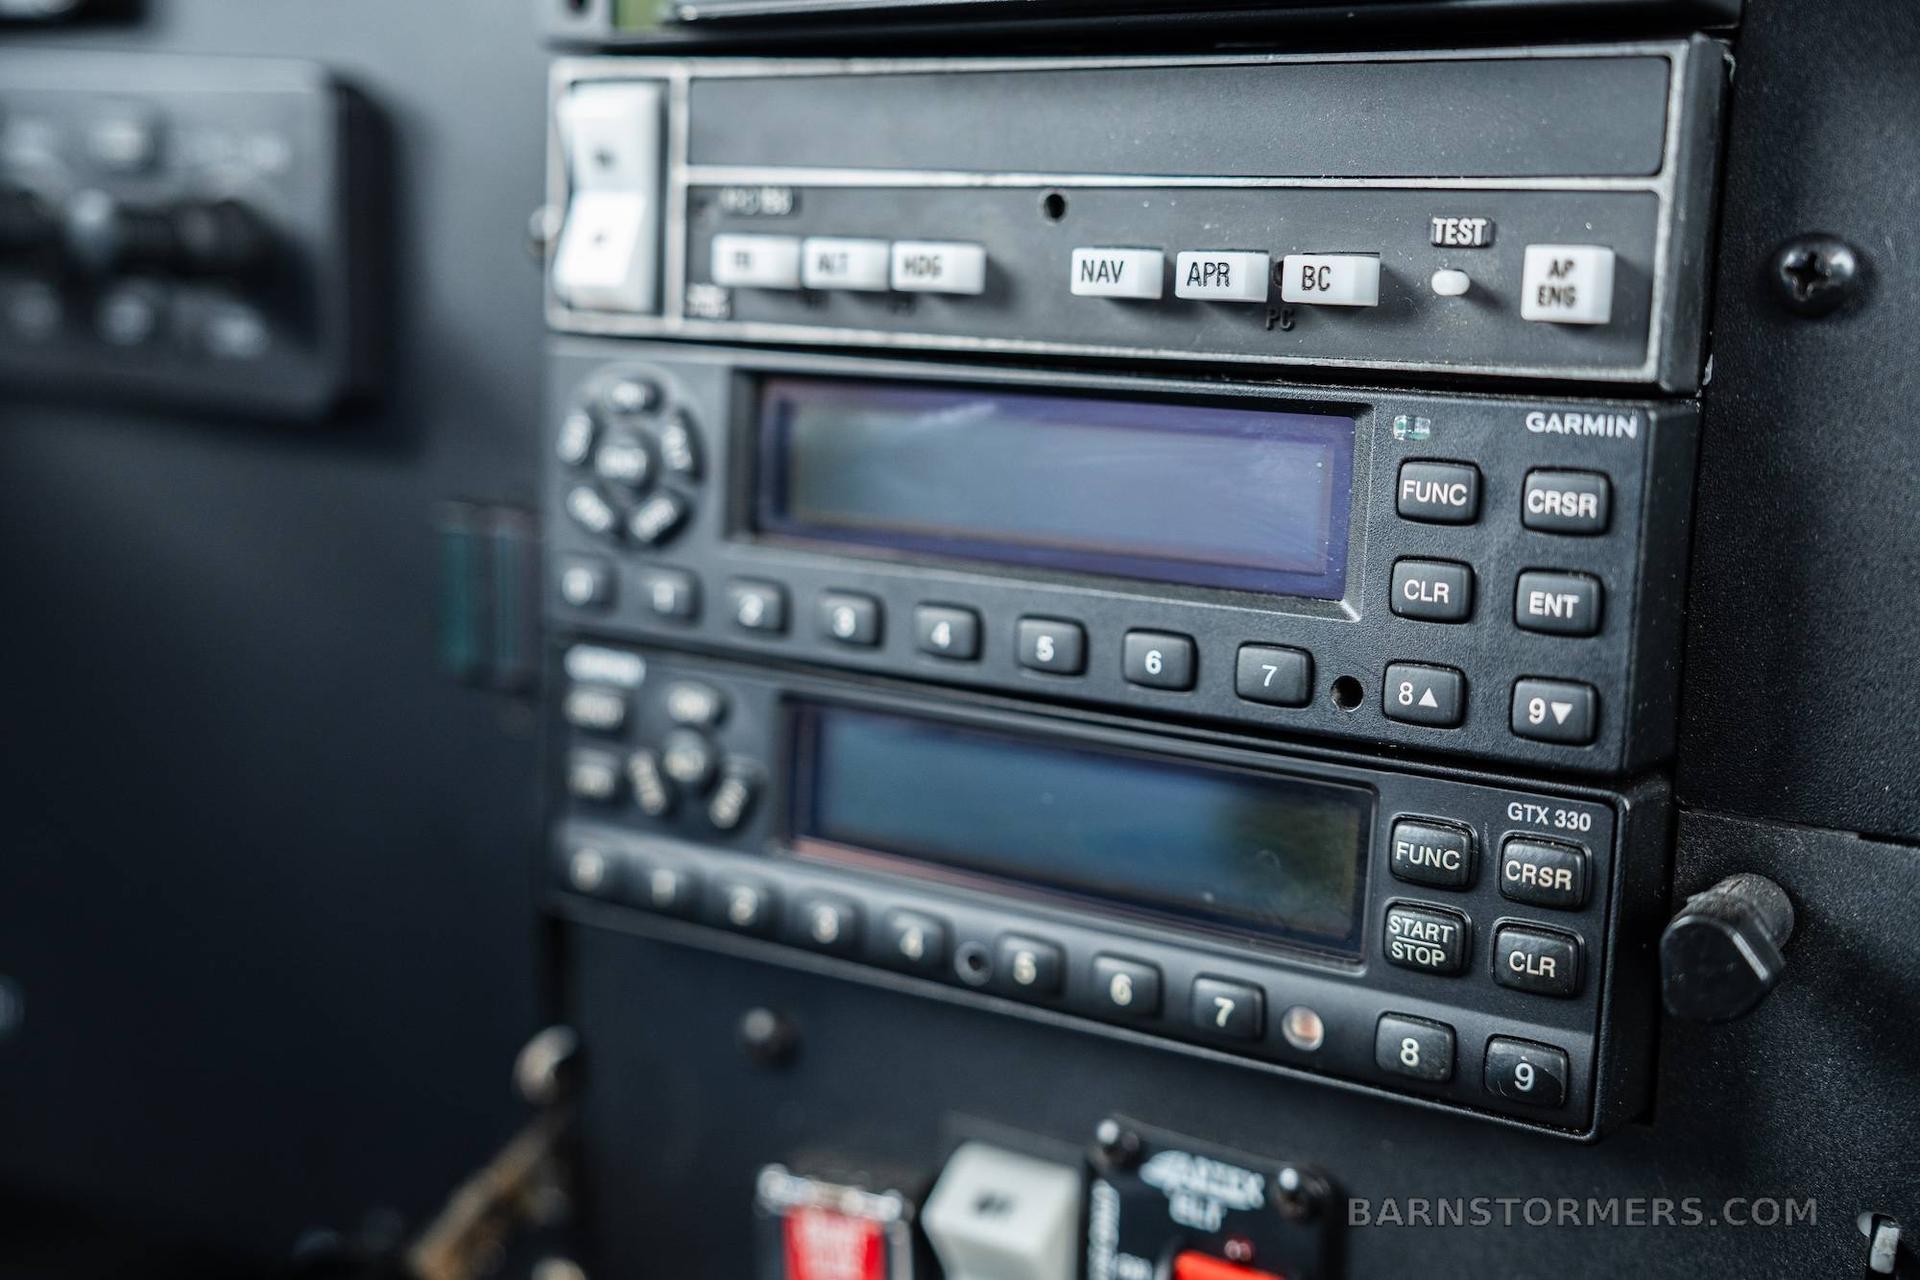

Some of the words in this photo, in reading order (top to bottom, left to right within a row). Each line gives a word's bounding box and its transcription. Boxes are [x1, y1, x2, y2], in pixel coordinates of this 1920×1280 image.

[1432, 217, 1487, 245] TEST
[1080, 259, 1124, 284] NAV
[1187, 261, 1231, 287] APR
[1301, 265, 1332, 292] BC
[1548, 259, 1575, 278] AP
[1538, 284, 1576, 308] ENG
[1265, 306, 1296, 331] PC
[1525, 411, 1638, 438] GARMIN
[1402, 479, 1468, 506] FUNC
[1527, 488, 1598, 518] CRSR
[1403, 579, 1449, 603] CLR
[1528, 591, 1580, 618] ENT
[1036, 634, 1055, 661] 5
[1144, 649, 1162, 674] 6
[1261, 664, 1278, 686] 7
[1398, 681, 1413, 705] 8
[1528, 697, 1546, 724] 9
[1507, 802, 1549, 826] GTX
[1554, 809, 1592, 832] 330
[1395, 841, 1461, 871] FUNC
[1505, 860, 1573, 891] CRSR
[1388, 915, 1454, 944] START
[1391, 940, 1447, 968] STOP
[1508, 950, 1556, 978] CLR
[1110, 973, 1133, 1006] 6
[1214, 996, 1236, 1027] 7
[1400, 1037, 1420, 1067] 8
[1514, 1063, 1535, 1091] 9
